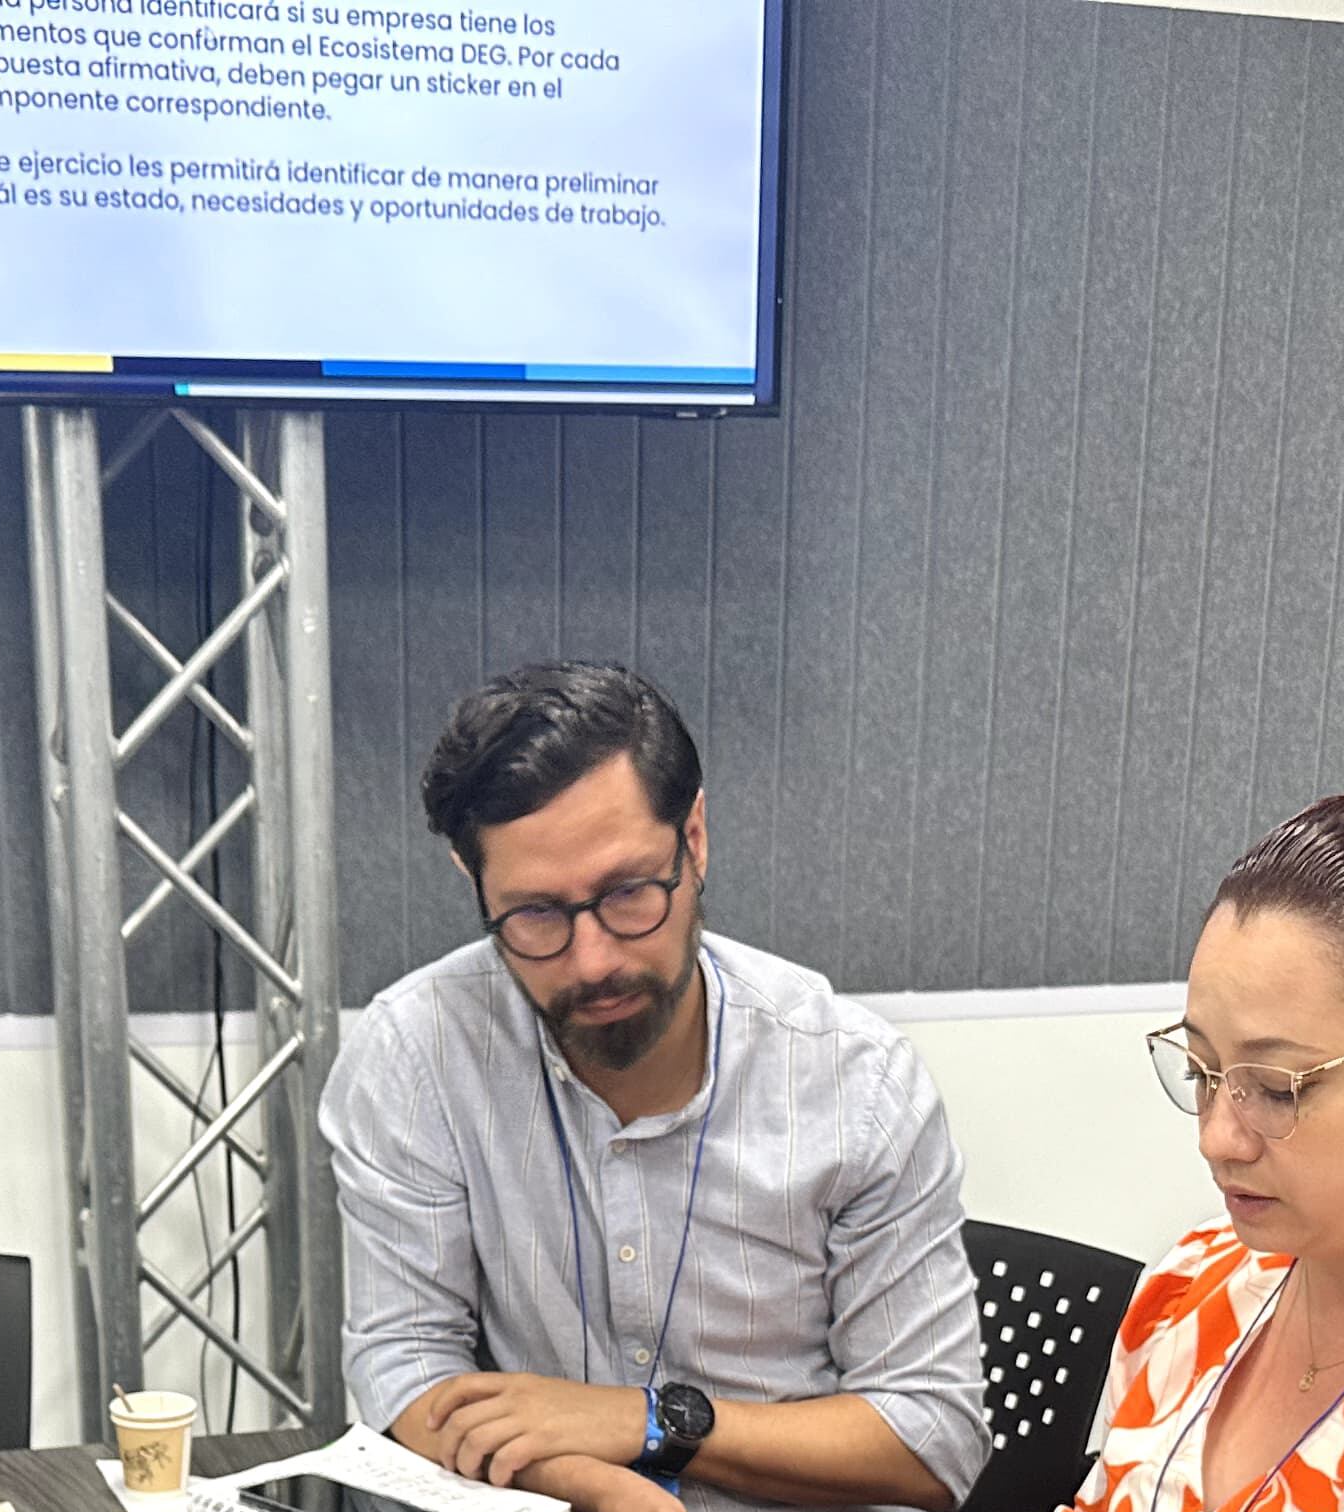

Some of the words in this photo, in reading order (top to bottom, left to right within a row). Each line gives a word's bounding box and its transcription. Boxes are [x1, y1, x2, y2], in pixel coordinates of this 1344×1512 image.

[288, 3, 304, 24] si
[312, 10, 339, 25] su
[347, 11, 452, 34] empresa
[460, 11, 516, 34] tiene
[524, 14, 555, 35] los
[94, 30, 141, 51] que
[148, 30, 284, 54] conforman
[292, 35, 312, 55] el
[320, 35, 453, 62] Ecosistema
[461, 42, 512, 64] DEG.
[519, 45, 555, 66] Por
[560, 48, 620, 69] cada
[88, 56, 221, 85] afirmativa,
[228, 62, 304, 85] deben
[312, 71, 383, 93] pegar
[391, 75, 419, 90] un
[427, 71, 501, 94] sticker
[508, 80, 536, 95] en
[543, 76, 562, 96] el
[126, 96, 332, 121] correspondiente.
[18, 152, 122, 178] ejercicio
[130, 156, 163, 177] les
[171, 159, 280, 183] permitirá
[288, 162, 406, 186] identificar
[412, 166, 441, 187] de
[448, 173, 538, 191] manera
[546, 173, 659, 198] preliminar
[24, 190, 51, 205] es
[59, 191, 87, 206] su
[95, 187, 184, 213] estado,
[192, 192, 344, 215] necesidades
[351, 201, 364, 221] y
[370, 197, 539, 222] oportunidades
[545, 202, 574, 222] de
[580, 203, 666, 231] trabajo.
